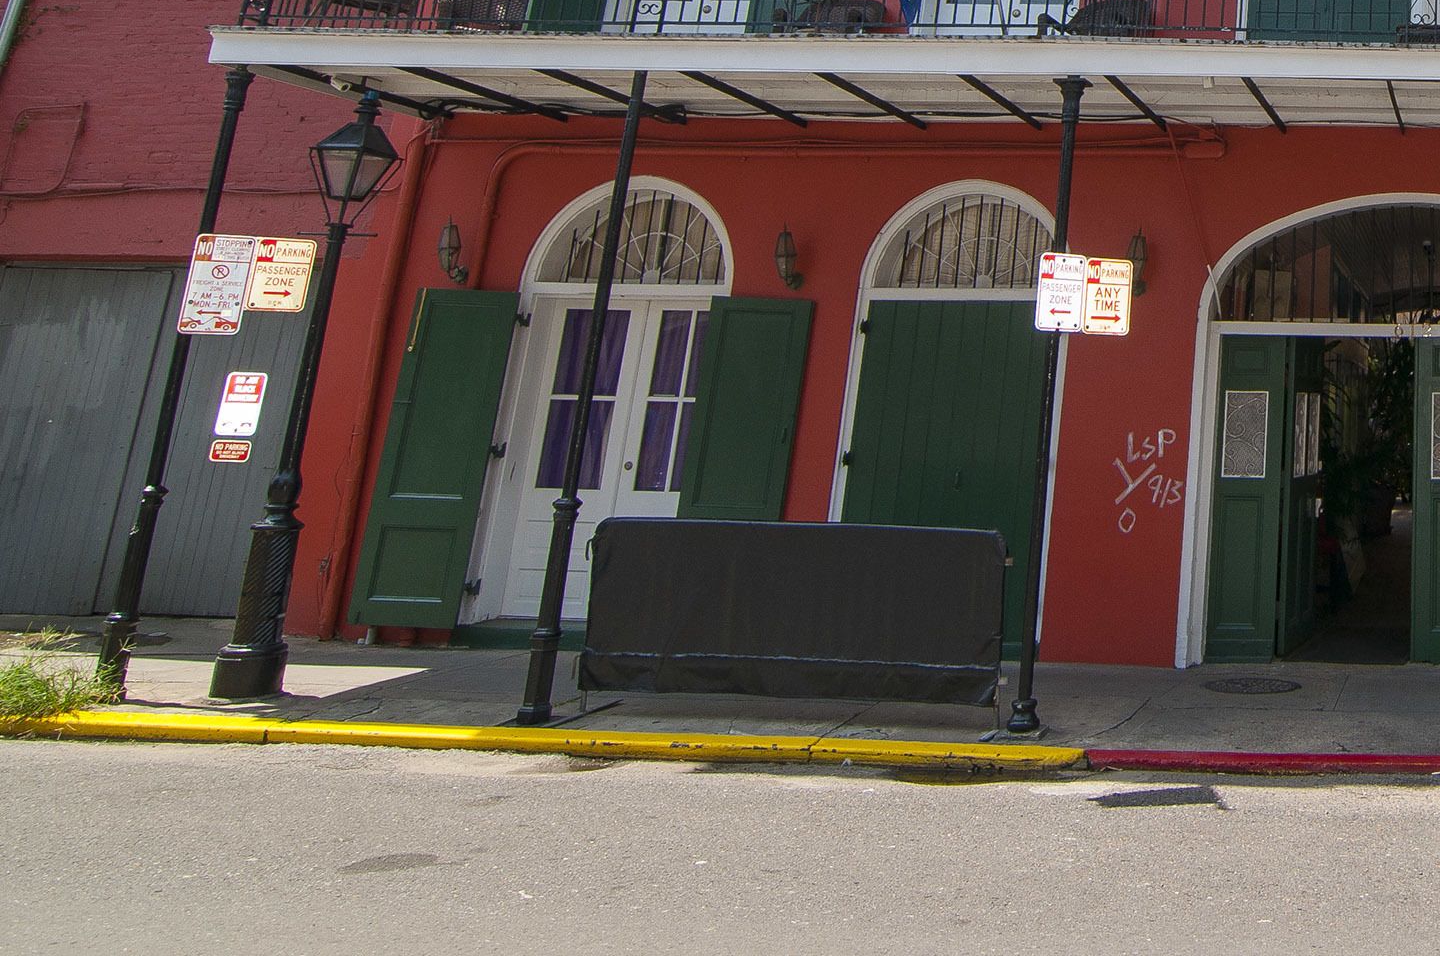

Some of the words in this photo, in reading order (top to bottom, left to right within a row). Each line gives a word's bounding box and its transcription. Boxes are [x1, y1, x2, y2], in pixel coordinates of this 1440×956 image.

[197, 241, 213, 256] NO
[259, 243, 275, 258] NO
[276, 247, 312, 259] PARKING
[256, 265, 308, 276] PASSENGER
[1042, 259, 1055, 274] NO
[1056, 263, 1083, 274] PARKING
[1088, 264, 1100, 279] NO
[1101, 268, 1129, 279] PARKING
[265, 277, 296, 287] ZONE
[1042, 282, 1081, 293] PASSENGER
[227, 293, 240, 301] PM
[1094, 287, 1121, 299] ANY
[1049, 294, 1073, 305] ZONE
[1094, 299, 1121, 312] TIME
